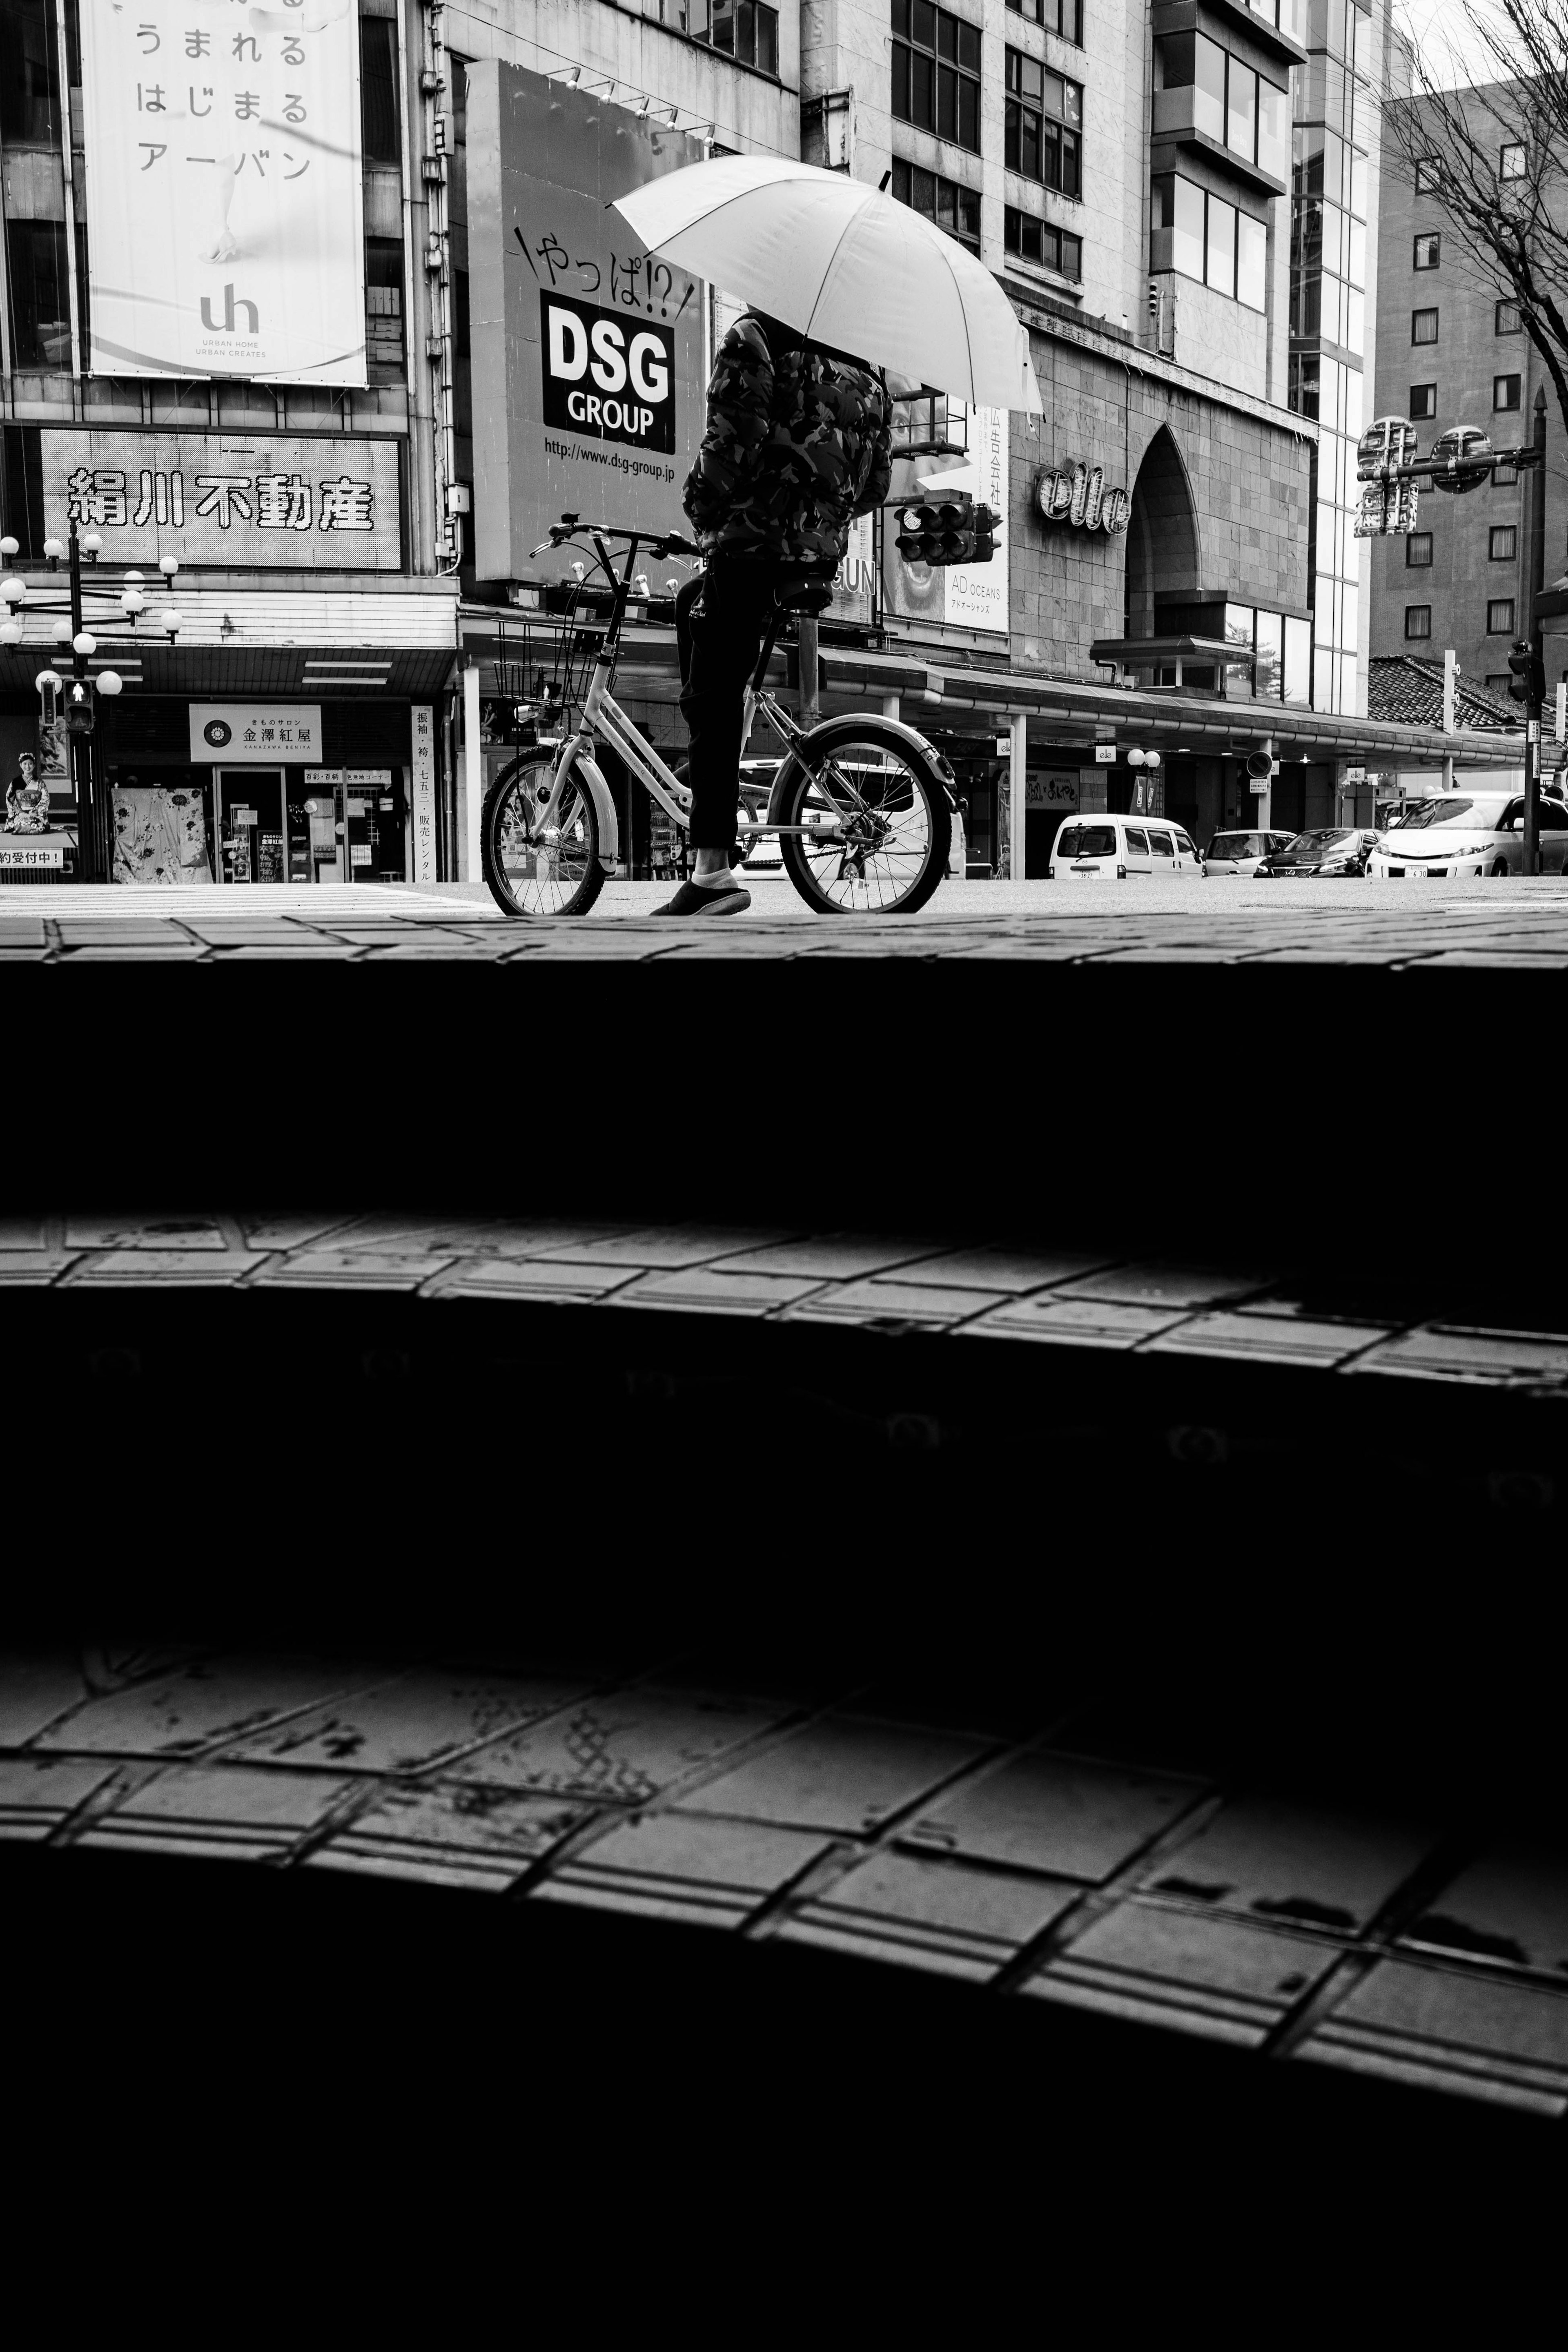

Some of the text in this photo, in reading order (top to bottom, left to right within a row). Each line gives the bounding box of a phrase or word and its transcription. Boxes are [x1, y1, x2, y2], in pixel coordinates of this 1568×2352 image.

[136, 23, 306, 65] うまれる
[138, 83, 307, 123] はじまる
[138, 143, 310, 179] アーバン
[549, 305, 668, 402] DSG
[568, 391, 653, 435] GROUP
[545, 437, 674, 483] http://www.dsg-group.jp
[68, 468, 373, 531] 絹川不動産
[951, 599, 990, 614] アドオーシャンズ
[952, 575, 1000, 599] AD OCEANS
[243, 728, 311, 742] 金澤紅屋
[1100, 748, 1111, 759] elle
